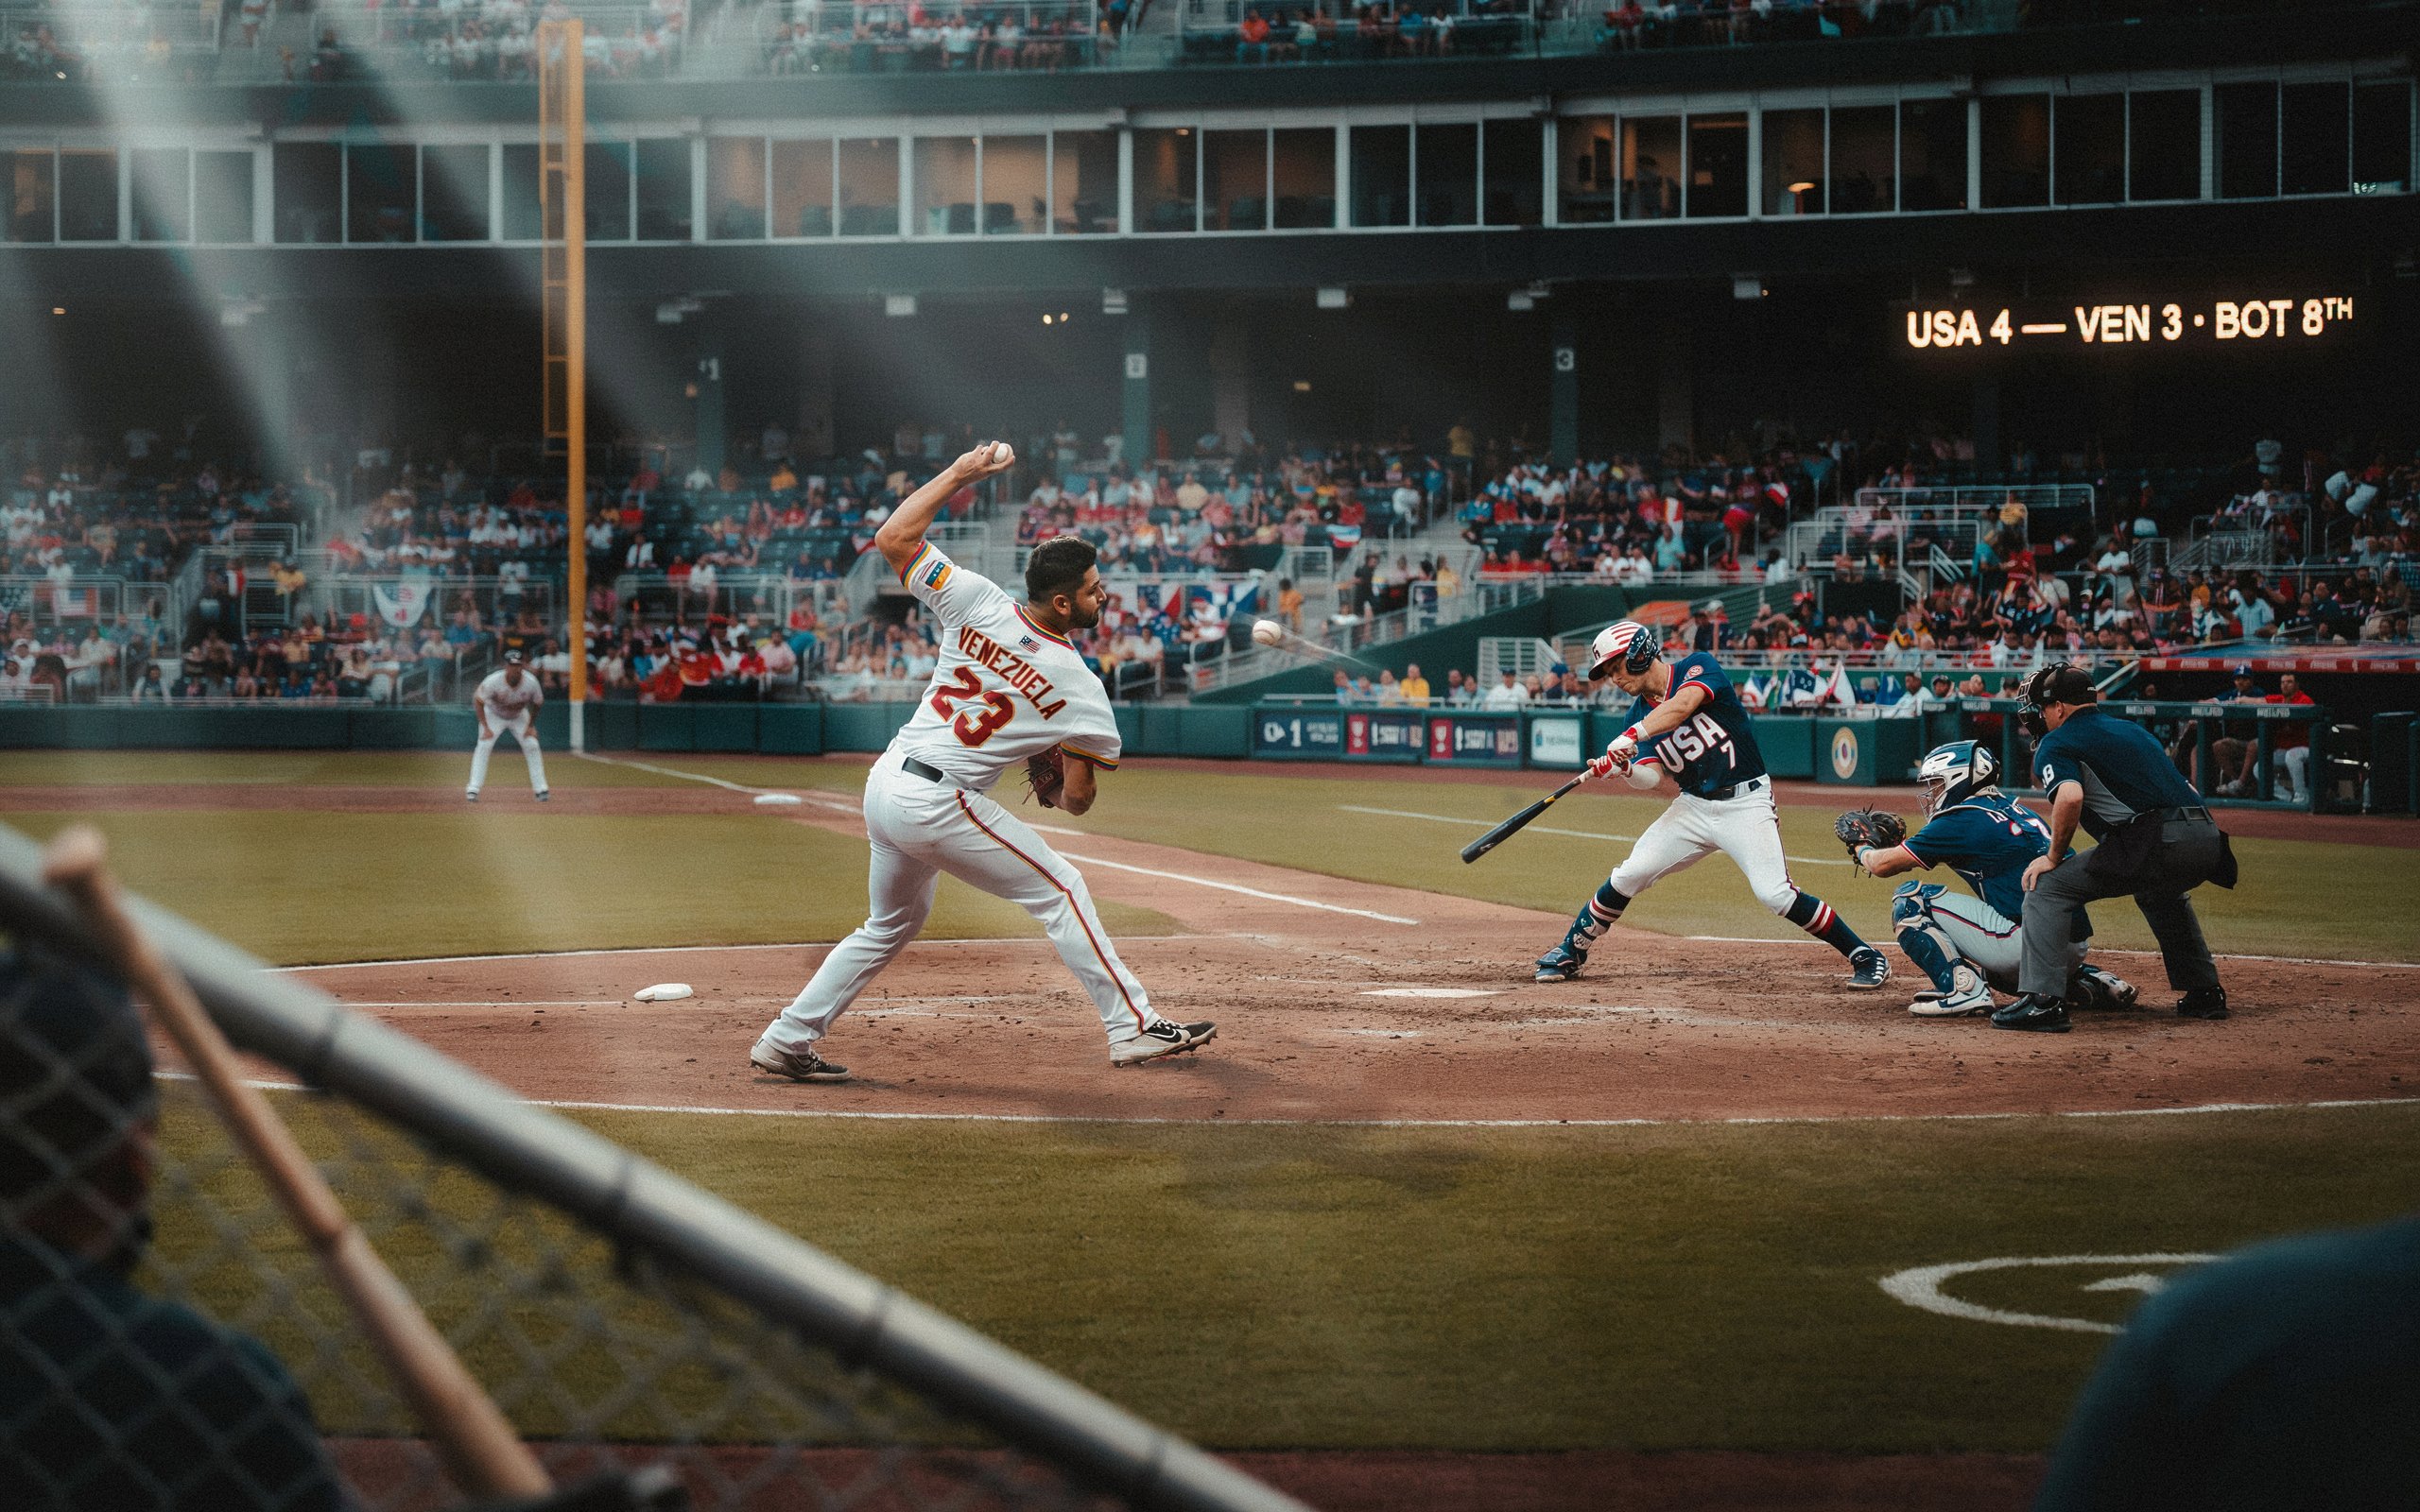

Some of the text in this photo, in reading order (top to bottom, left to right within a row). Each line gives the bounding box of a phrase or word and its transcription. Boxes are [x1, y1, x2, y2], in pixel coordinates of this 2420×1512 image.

[1907, 309, 1982, 348] USA
[1989, 308, 2014, 345] 4
[2074, 304, 2151, 343] VEN
[2161, 302, 2184, 341] 3
[2215, 300, 2293, 339] BOT
[2302, 296, 2354, 336] 8TH
[1556, 348, 1575, 371] 3
[958, 625, 1068, 722] VENEZUELA
[930, 664, 1016, 749] 23
[1654, 712, 1728, 774] USA
[1720, 739, 1736, 770] 7
